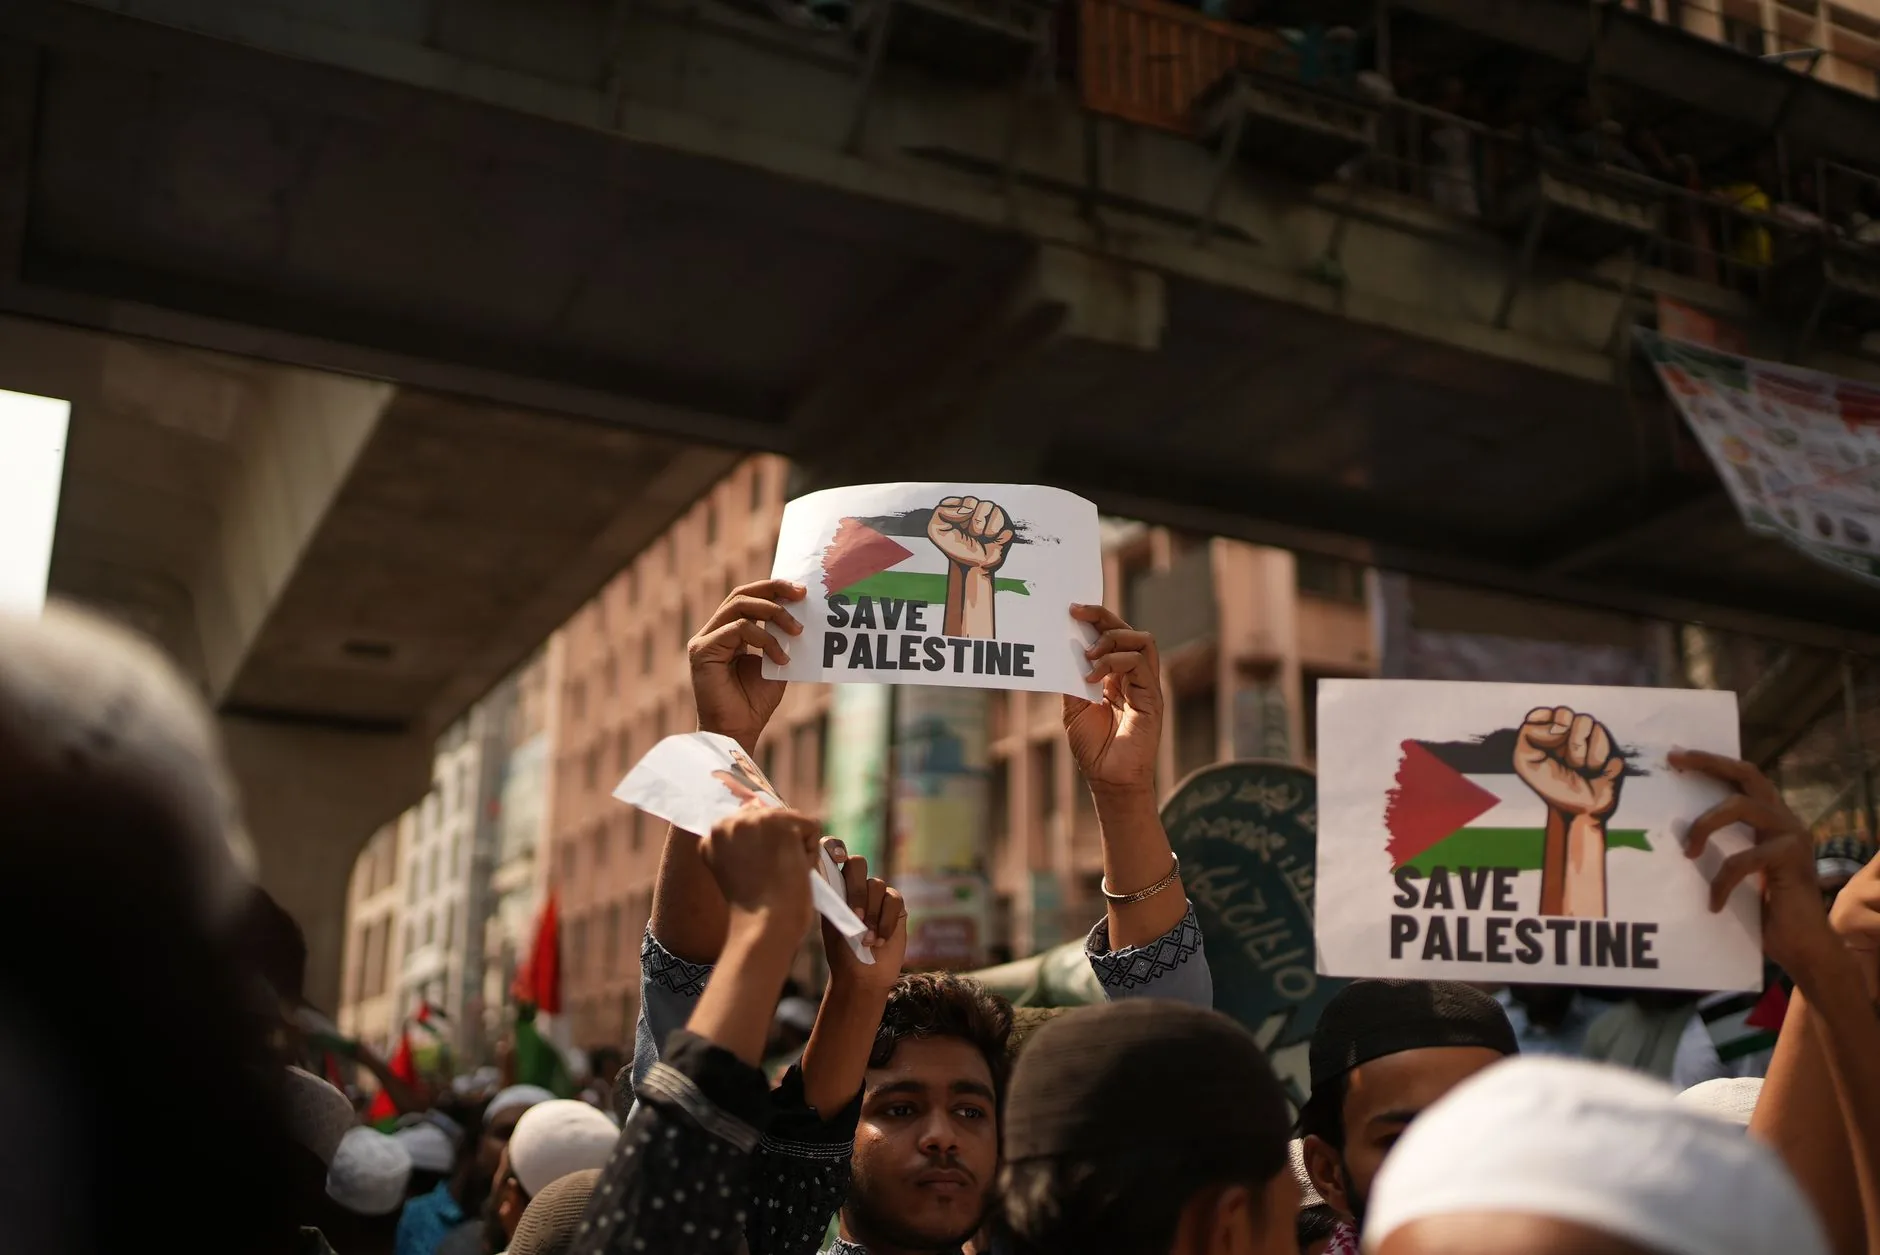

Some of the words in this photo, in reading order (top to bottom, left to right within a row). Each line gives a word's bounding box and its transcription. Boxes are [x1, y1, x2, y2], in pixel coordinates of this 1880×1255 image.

[826, 595, 928, 632] SAVE
[822, 631, 1035, 678] PALESTINE
[1393, 865, 1519, 912] SAVE
[1390, 914, 1660, 970] PALESTINE
